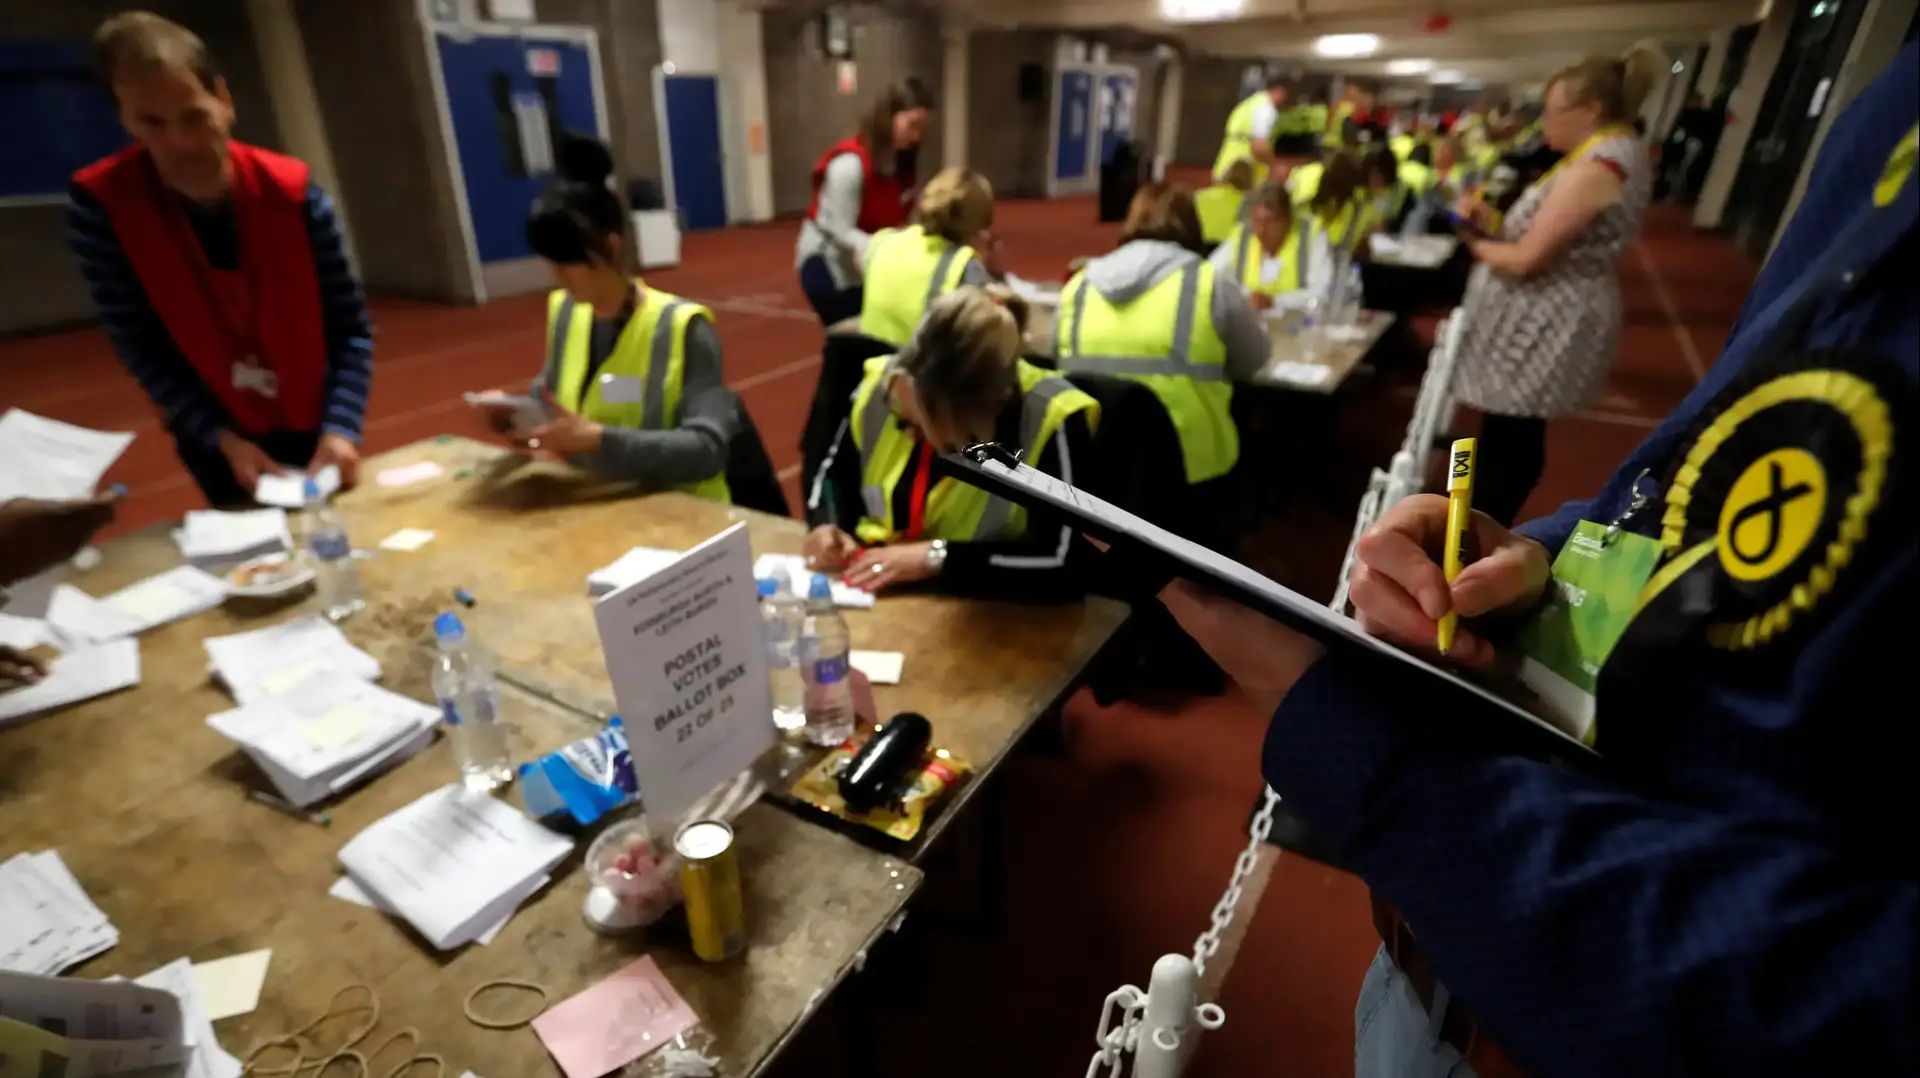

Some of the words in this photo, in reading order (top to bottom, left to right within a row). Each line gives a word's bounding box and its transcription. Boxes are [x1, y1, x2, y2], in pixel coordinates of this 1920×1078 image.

[664, 632, 723, 678] POSTAL
[672, 652, 723, 693] VOTES
[654, 681, 713, 732] BALLOT
[716, 661, 747, 692] BOX
